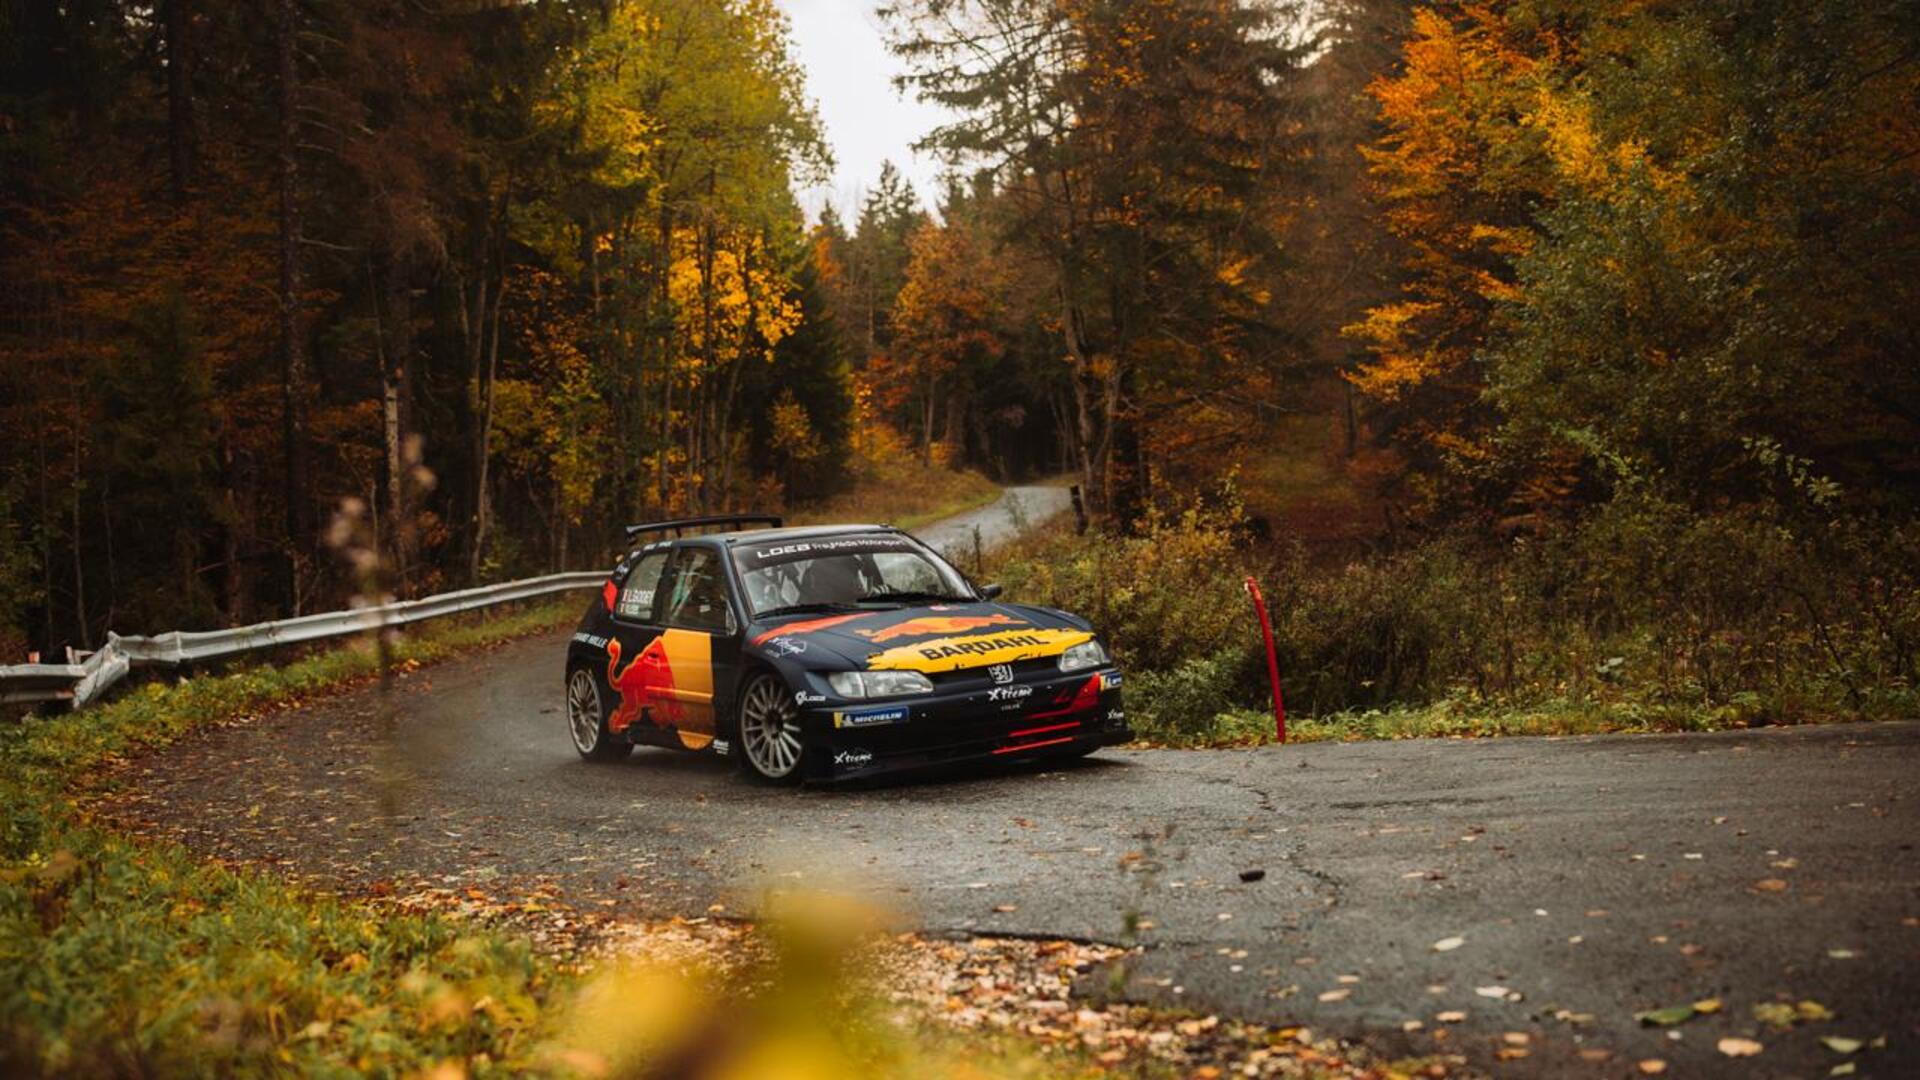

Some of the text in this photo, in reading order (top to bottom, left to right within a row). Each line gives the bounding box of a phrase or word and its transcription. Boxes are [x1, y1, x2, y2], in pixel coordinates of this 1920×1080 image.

[757, 543, 811, 558] LOEB
[919, 635, 1051, 661] BARDAHL
[854, 711, 903, 724] MICHELIN
